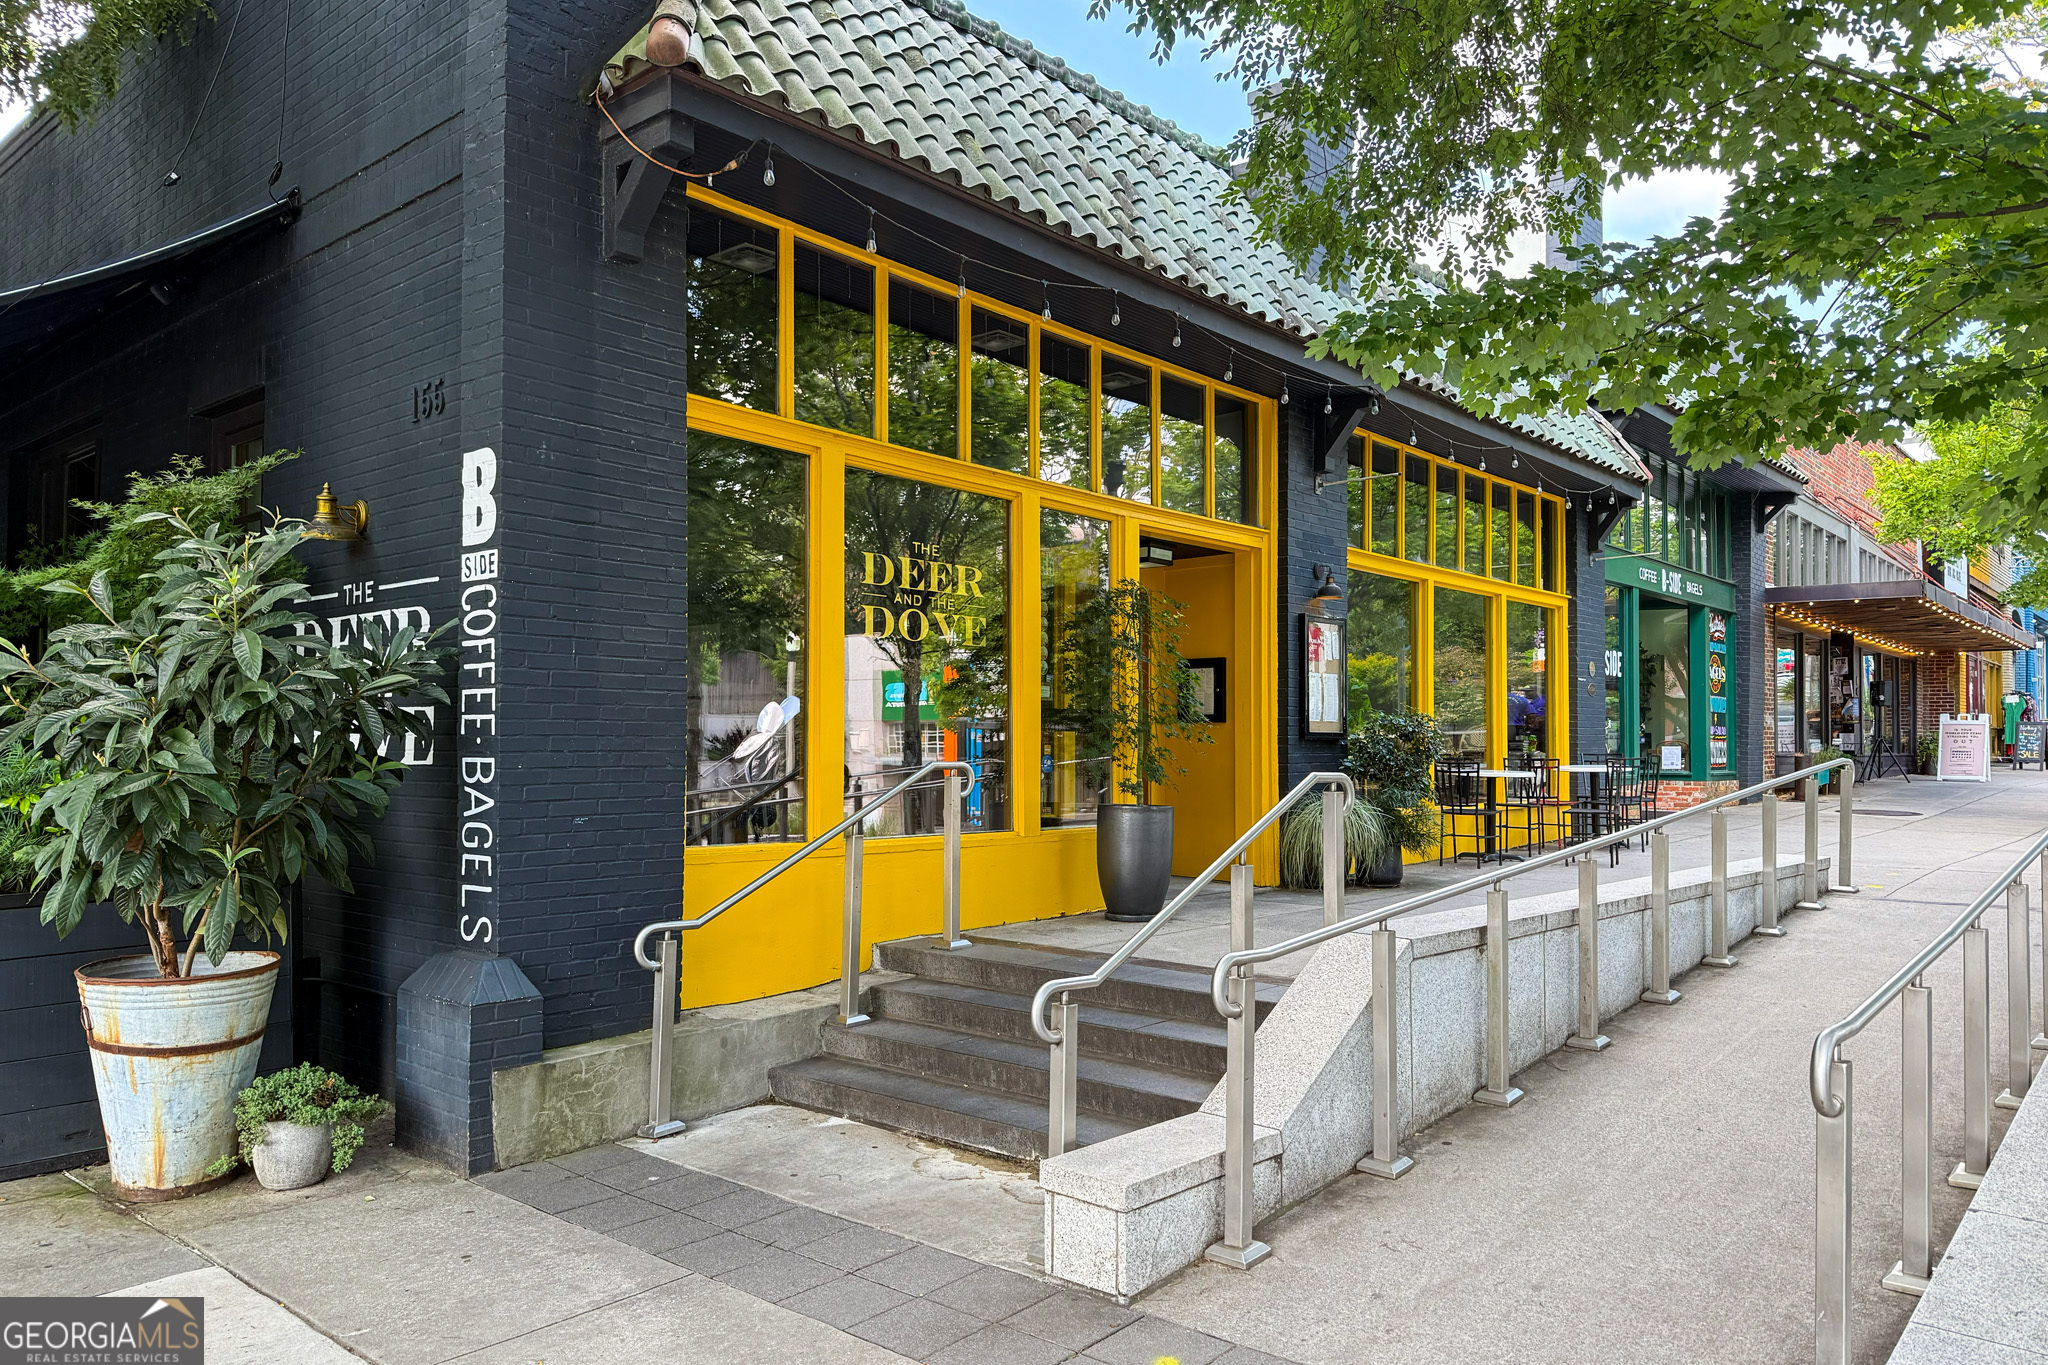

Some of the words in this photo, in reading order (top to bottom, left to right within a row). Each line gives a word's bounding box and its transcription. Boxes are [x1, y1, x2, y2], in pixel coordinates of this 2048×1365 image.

[411, 378, 445, 424] 155
[461, 447, 497, 547] B
[464, 552, 496, 579] SIDE
[912, 541, 940, 557] THE
[343, 580, 374, 606] THE
[861, 551, 985, 598] DEER
[1639, 567, 1657, 584] COFFEE
[1686, 580, 1703, 596] BAGELS
[894, 592, 922, 607] AND
[929, 596, 955, 611] THE
[861, 604, 987, 648] DOVE
[461, 584, 497, 736] COFFEE
[460, 757, 496, 943] BAGELS
